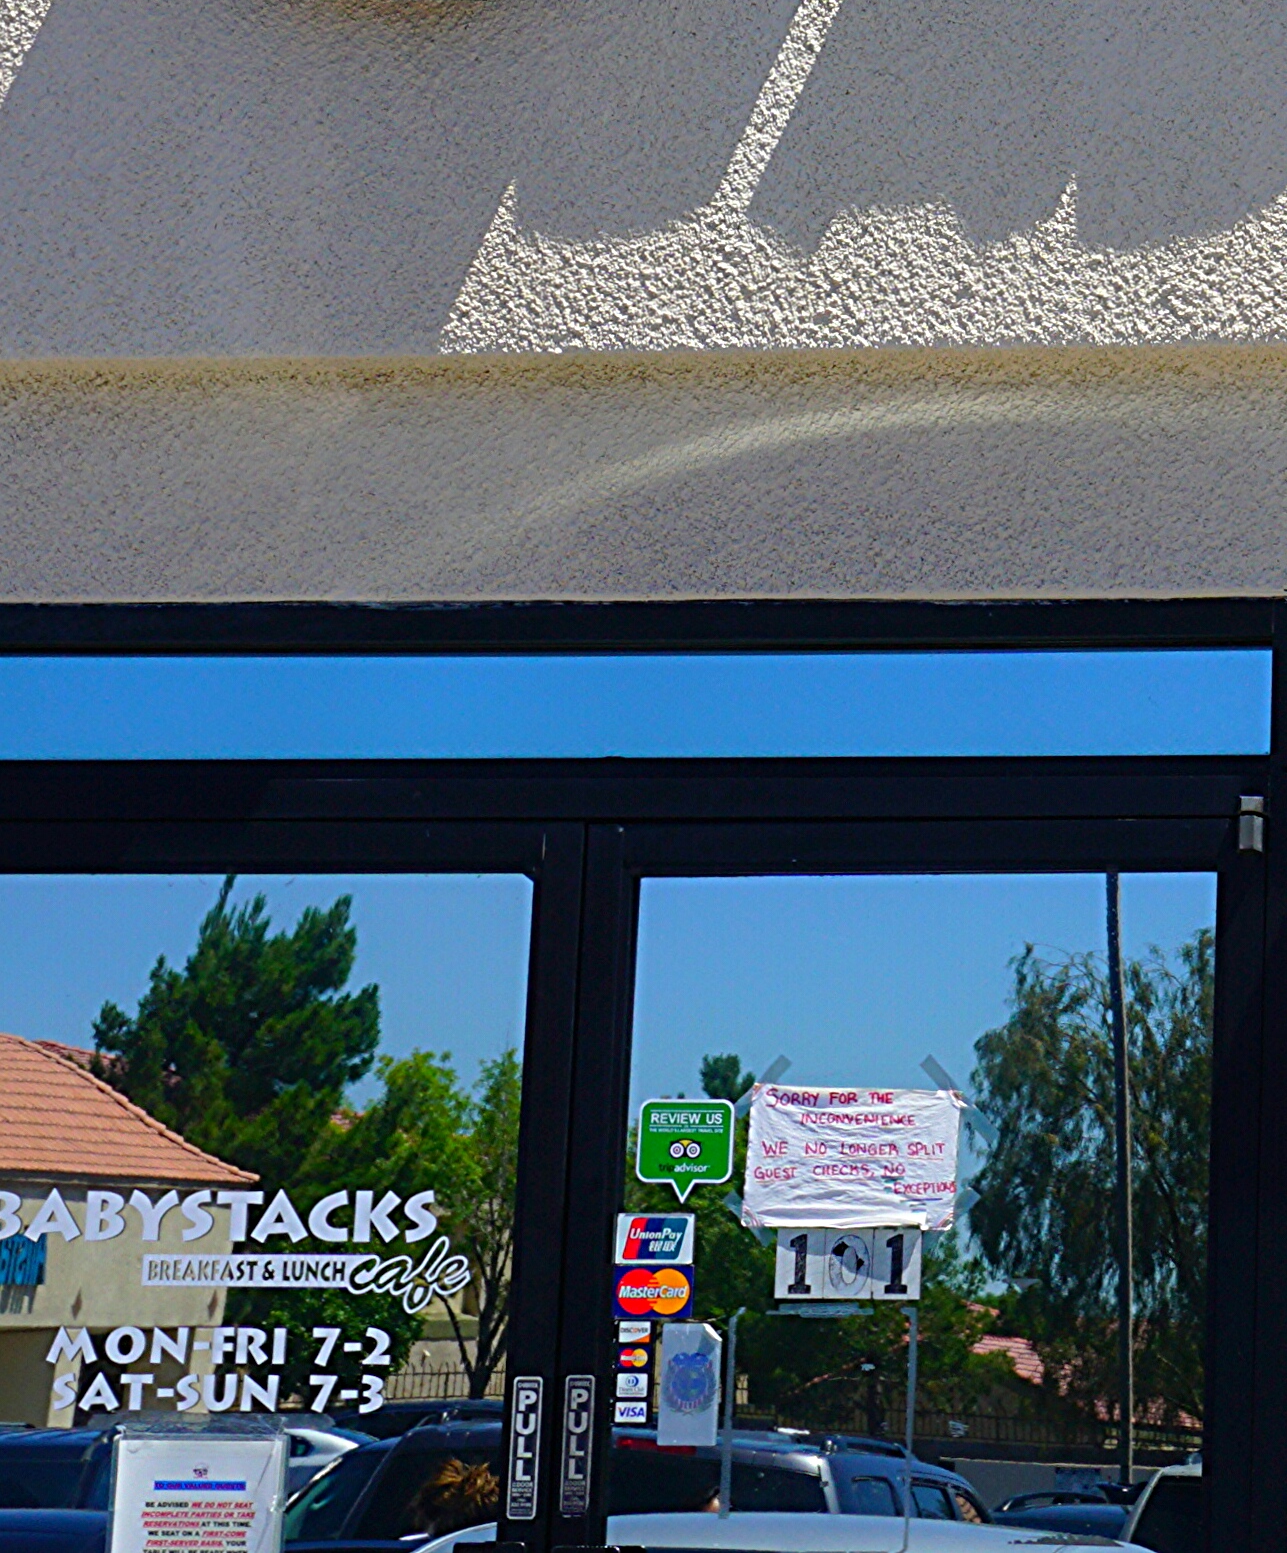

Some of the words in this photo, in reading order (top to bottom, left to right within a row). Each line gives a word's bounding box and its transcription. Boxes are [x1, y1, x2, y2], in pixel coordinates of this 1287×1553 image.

[765, 1087, 820, 1108] SORRY
[828, 1091, 859, 1105] FOR
[868, 1092, 894, 1104] THE
[650, 1113, 701, 1125] REVIEW
[705, 1113, 723, 1125] US
[800, 1112, 916, 1126] INCONVENIENCE
[761, 1141, 789, 1156] WE
[804, 1141, 828, 1155] NO
[839, 1142, 900, 1156] LONGER
[906, 1142, 946, 1156] SPLIT
[658, 1162, 708, 1174] tripadvisor
[753, 1165, 798, 1180] GUEST
[812, 1163, 875, 1177] CHECKS,
[882, 1163, 906, 1176] NO
[893, 1181, 958, 1195] EXCEPTIONS
[0, 1187, 438, 1243] BABYSTACKS
[629, 1227, 683, 1244] UnionPay
[788, 1233, 908, 1295] 101
[147, 1259, 258, 1282] BREAKFAST
[262, 1259, 276, 1282] &
[281, 1259, 347, 1283] LUNCH
[347, 1236, 472, 1314] cafe
[618, 1285, 688, 1299] MasterCard
[45, 1325, 287, 1365] MON-FRI
[312, 1327, 392, 1367] 7-2
[52, 1371, 281, 1413] SAT-SUN
[309, 1374, 385, 1414] 7-3
[617, 1406, 646, 1418] VISA
[515, 1389, 538, 1481] PULL
[567, 1388, 590, 1480] PULL
